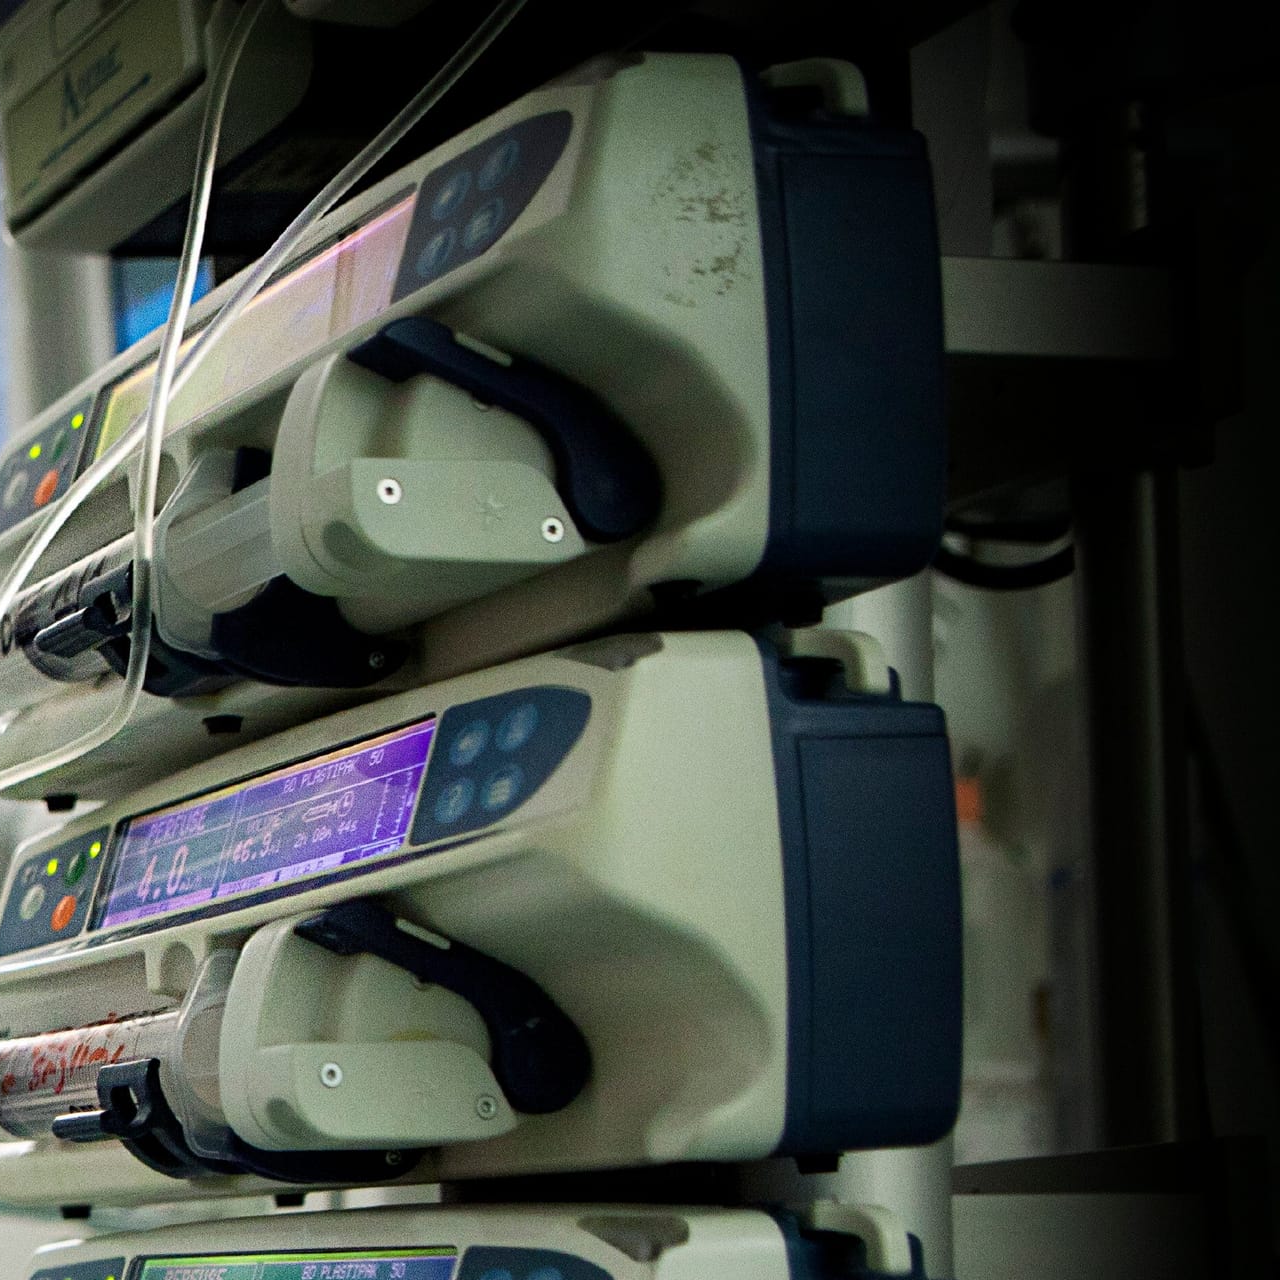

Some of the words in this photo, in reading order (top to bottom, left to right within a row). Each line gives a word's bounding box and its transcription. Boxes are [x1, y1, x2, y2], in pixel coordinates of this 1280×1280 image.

[368, 748, 386, 767] 50
[148, 806, 208, 844] PERFUSE
[388, 1263, 407, 1278] 50
